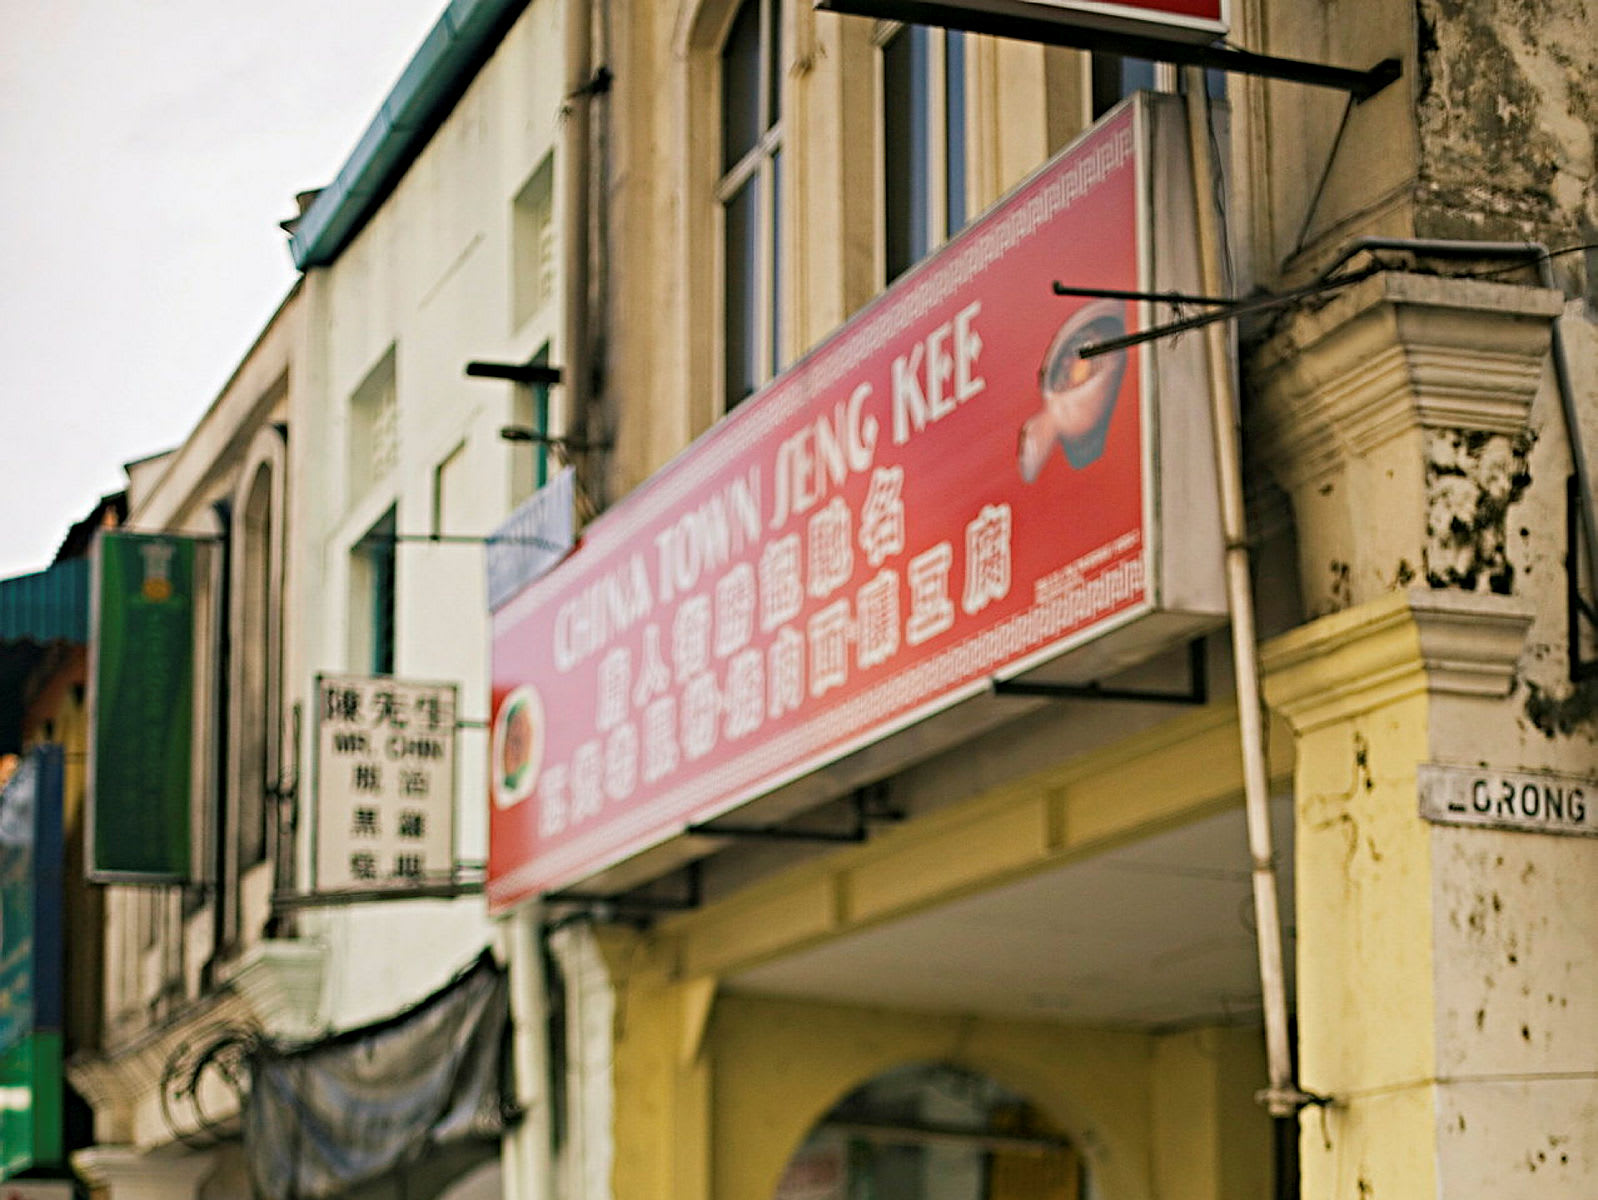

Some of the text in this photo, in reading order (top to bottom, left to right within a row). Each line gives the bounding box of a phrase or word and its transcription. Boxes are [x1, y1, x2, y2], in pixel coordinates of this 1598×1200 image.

[554, 300, 987, 673] CHINA TOWN SENG KEE
